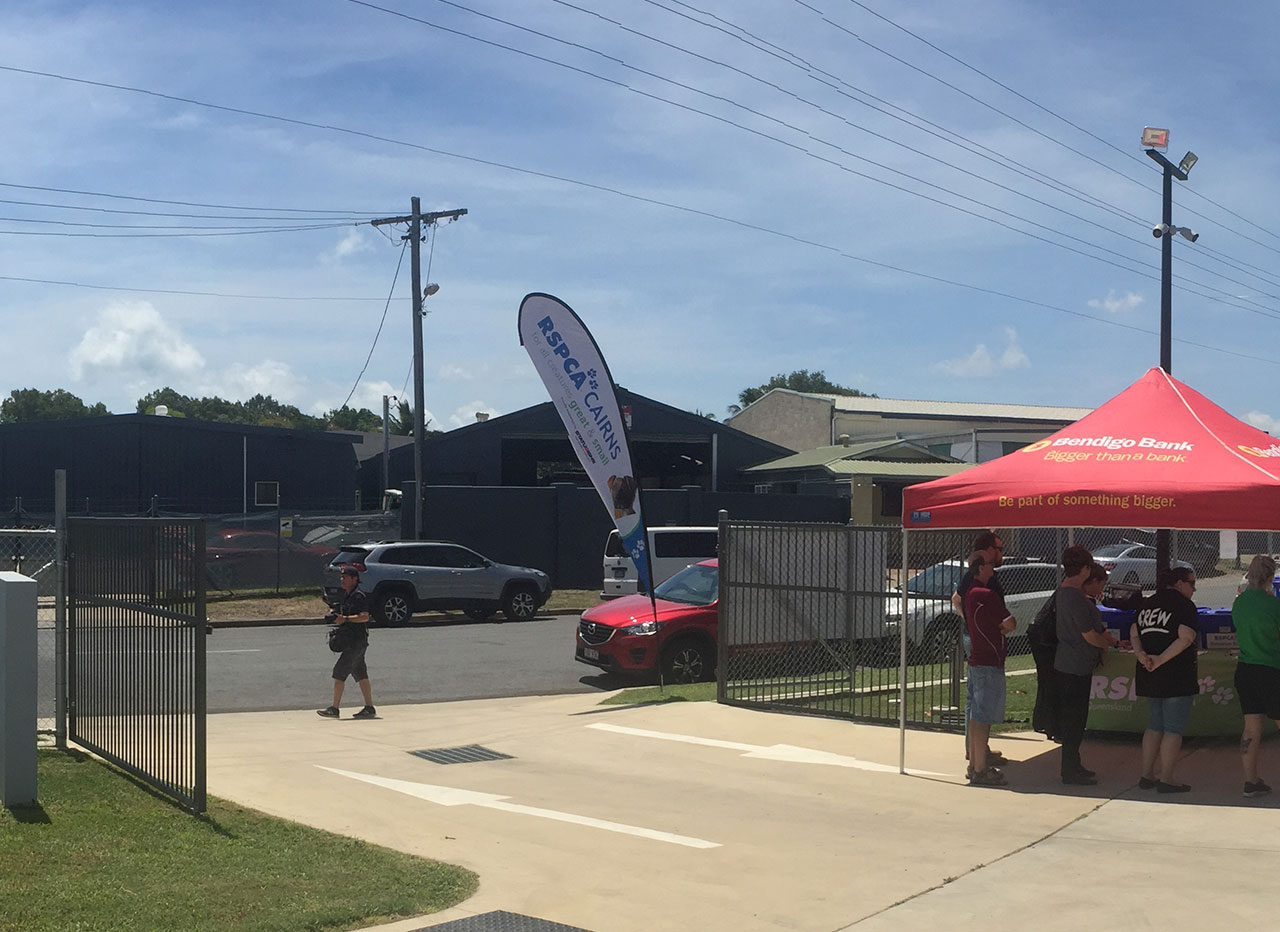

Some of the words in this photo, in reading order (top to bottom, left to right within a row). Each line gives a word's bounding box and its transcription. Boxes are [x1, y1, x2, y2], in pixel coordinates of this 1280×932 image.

[537, 315, 588, 391] RSPCA
[584, 391, 622, 461] CAIRNS
[568, 400, 589, 429] great
[592, 438, 609, 466] small
[1052, 436, 1136, 450] Bendigo
[1137, 437, 1195, 451] Bank
[1043, 450, 1094, 463] Bigger
[1096, 451, 1132, 461] than
[1132, 453, 1143, 461] a
[1145, 452, 1188, 463] bank
[999, 496, 1015, 507] Be
[1018, 494, 1043, 509] part
[1047, 493, 1060, 506] of
[1063, 494, 1130, 509] something
[1133, 494, 1176, 510] bigger.
[1138, 607, 1172, 627] CREW
